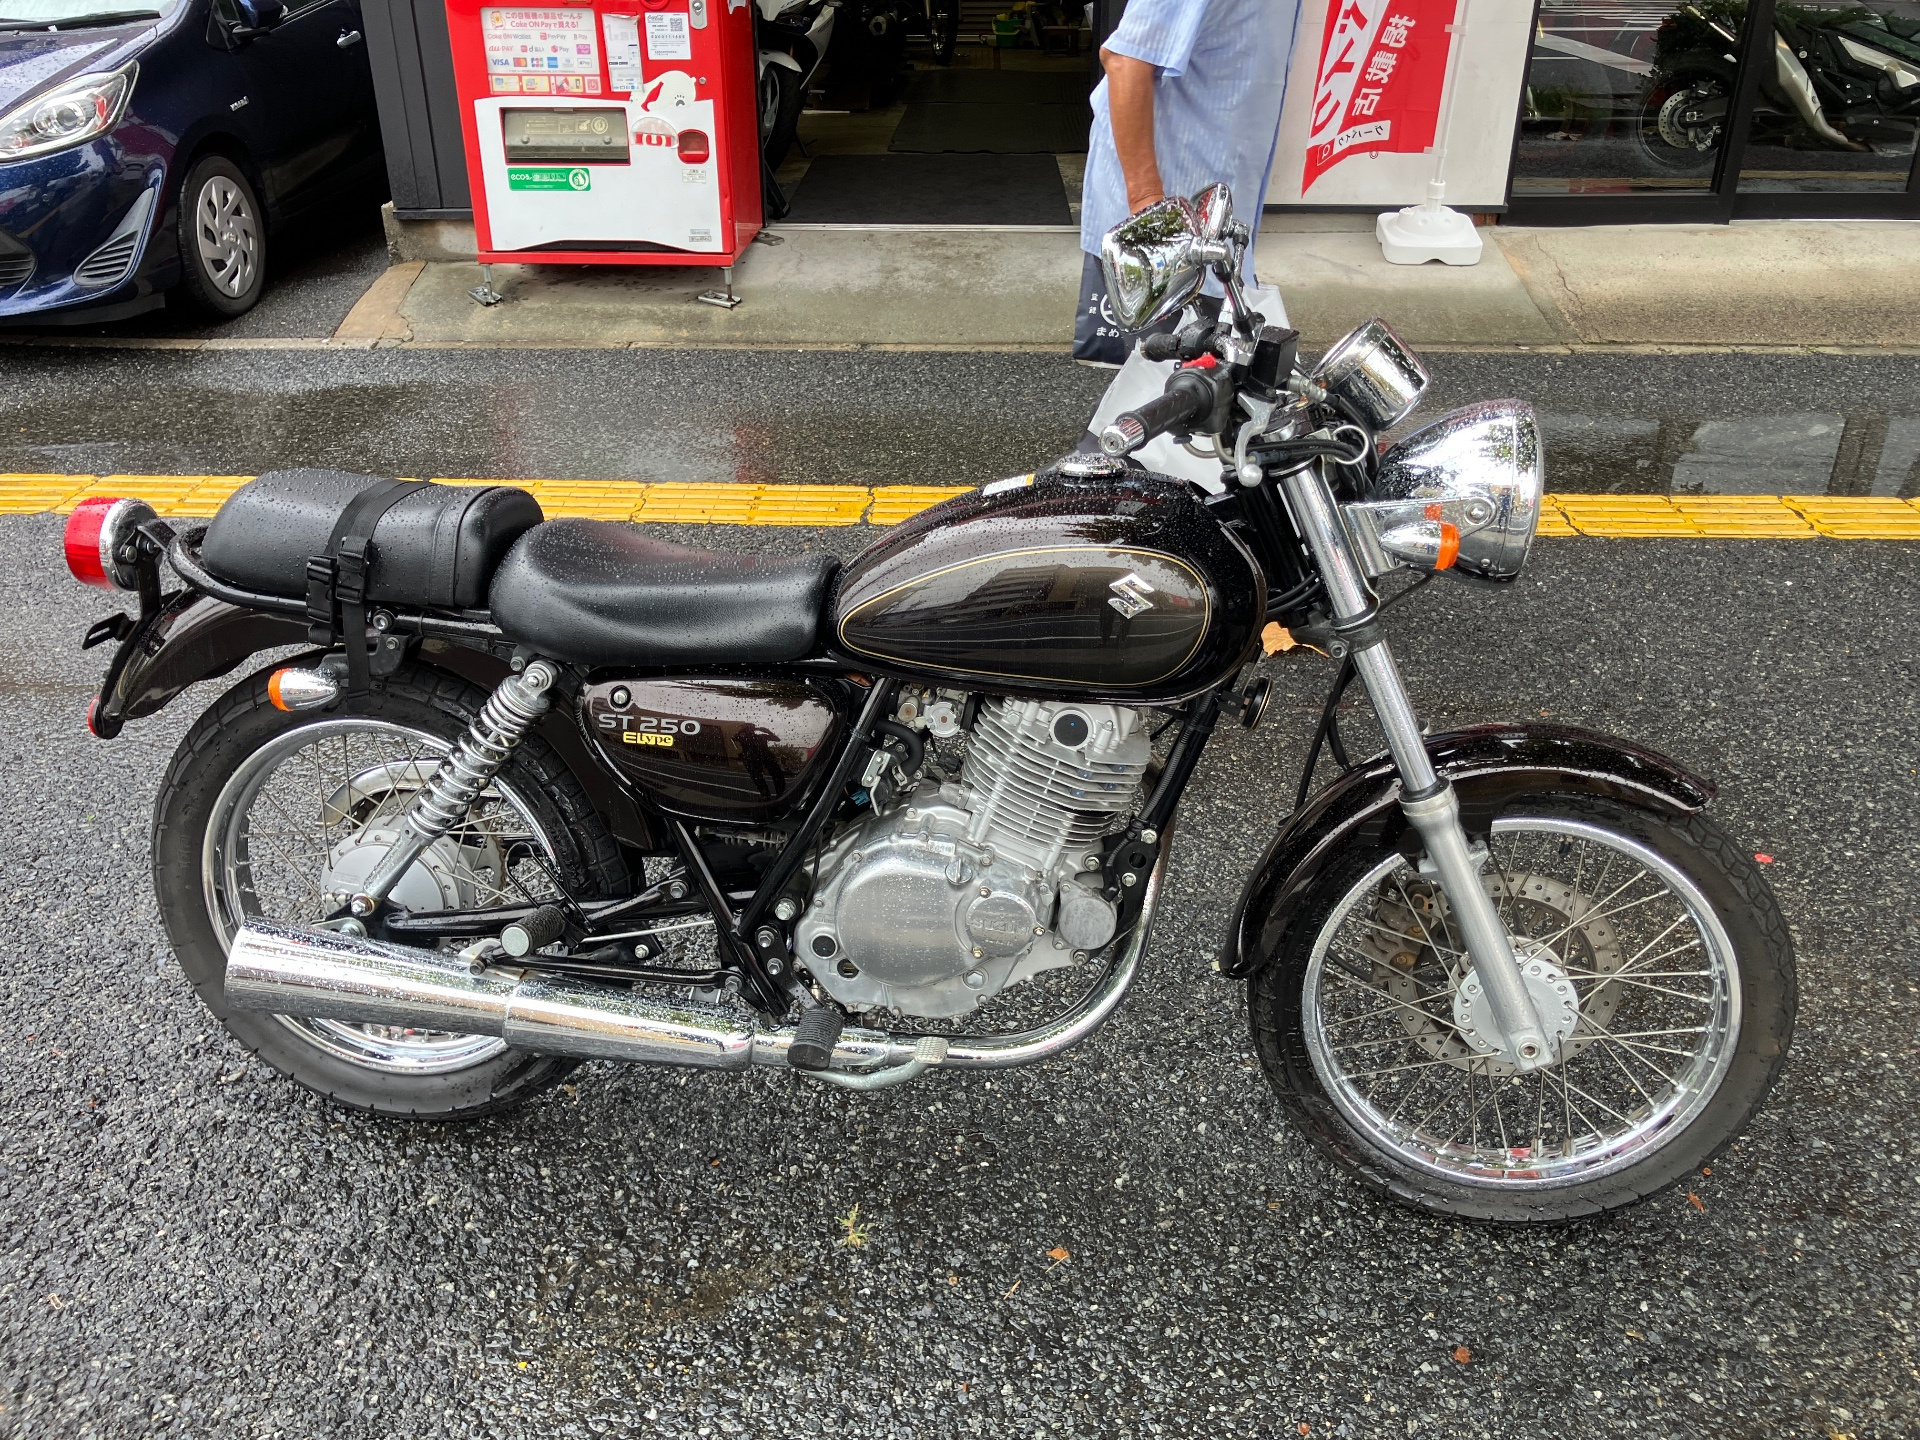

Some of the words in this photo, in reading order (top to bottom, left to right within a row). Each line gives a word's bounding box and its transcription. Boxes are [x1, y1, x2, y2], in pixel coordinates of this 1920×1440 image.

[529, 20, 540, 28] ON
[492, 58, 510, 66] VISA
[1096, 326, 1121, 338] まめ
[598, 713, 635, 730] ST
[639, 716, 701, 735] 250
[971, 918, 1031, 936] SUZUKI
